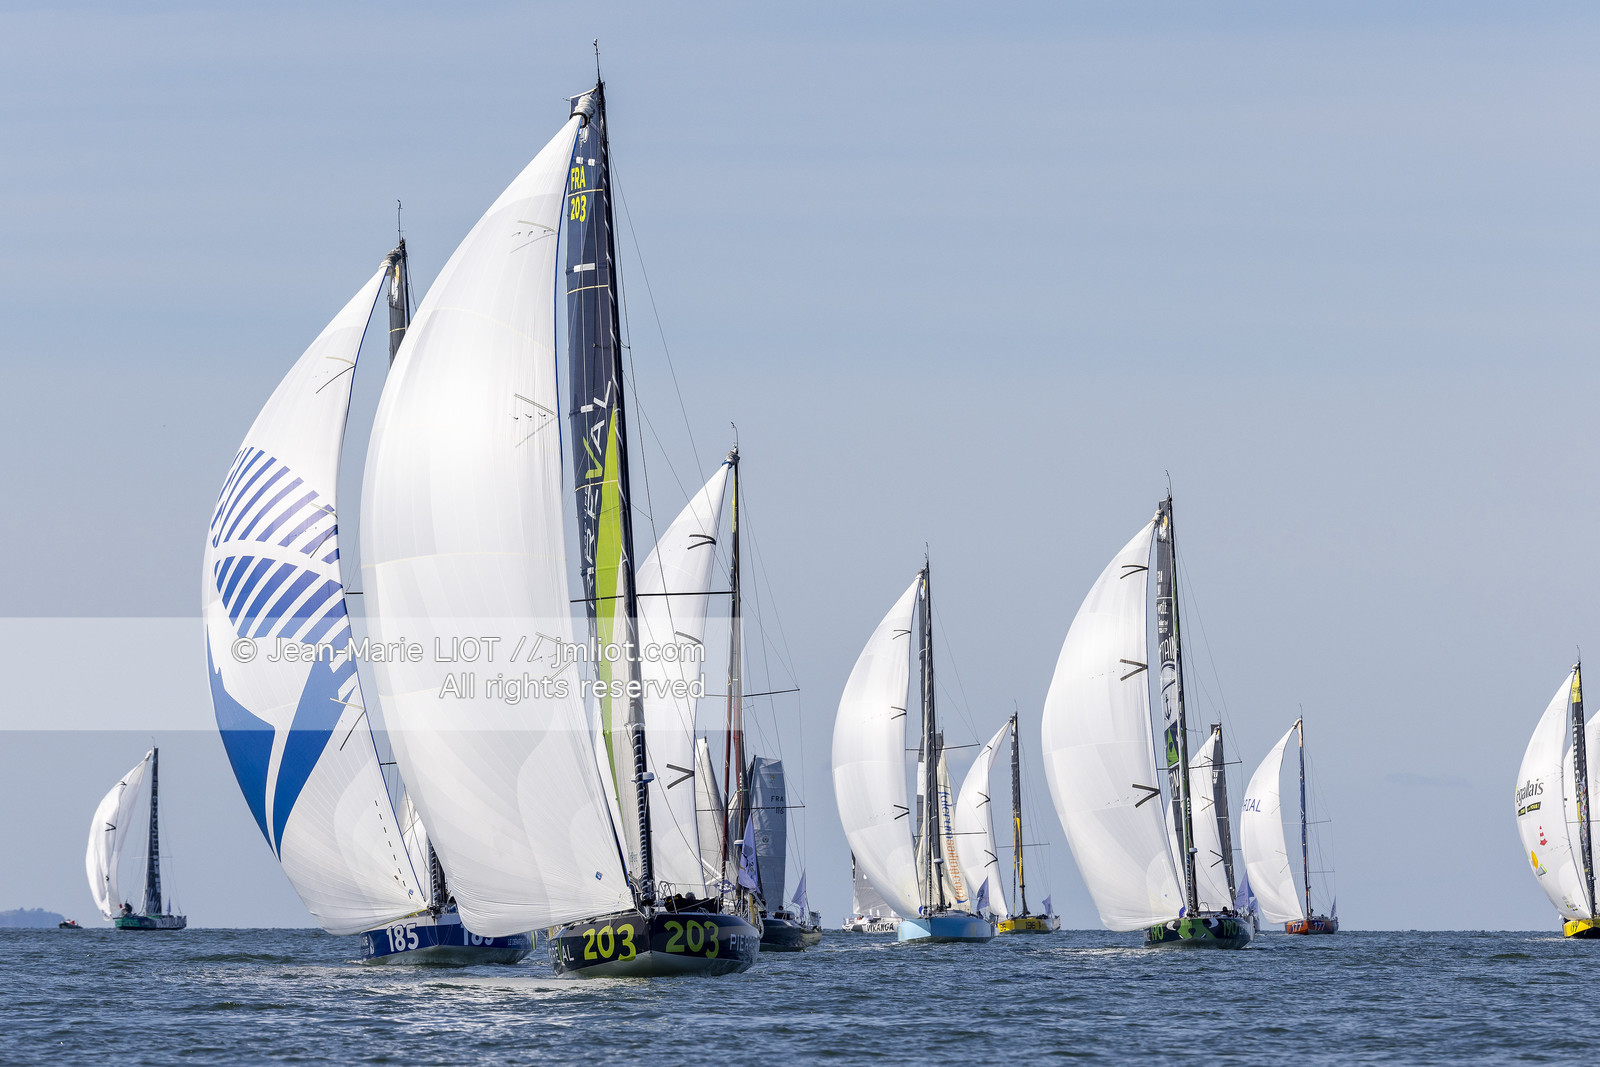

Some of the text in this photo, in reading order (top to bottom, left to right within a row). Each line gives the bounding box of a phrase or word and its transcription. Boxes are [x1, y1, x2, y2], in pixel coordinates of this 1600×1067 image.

[571, 166, 586, 191] FRA
[570, 195, 587, 222] 203
[386, 923, 419, 953] 185
[664, 919, 720, 959] 203
[1222, 919, 1238, 937] 190
[582, 923, 637, 962] 203
